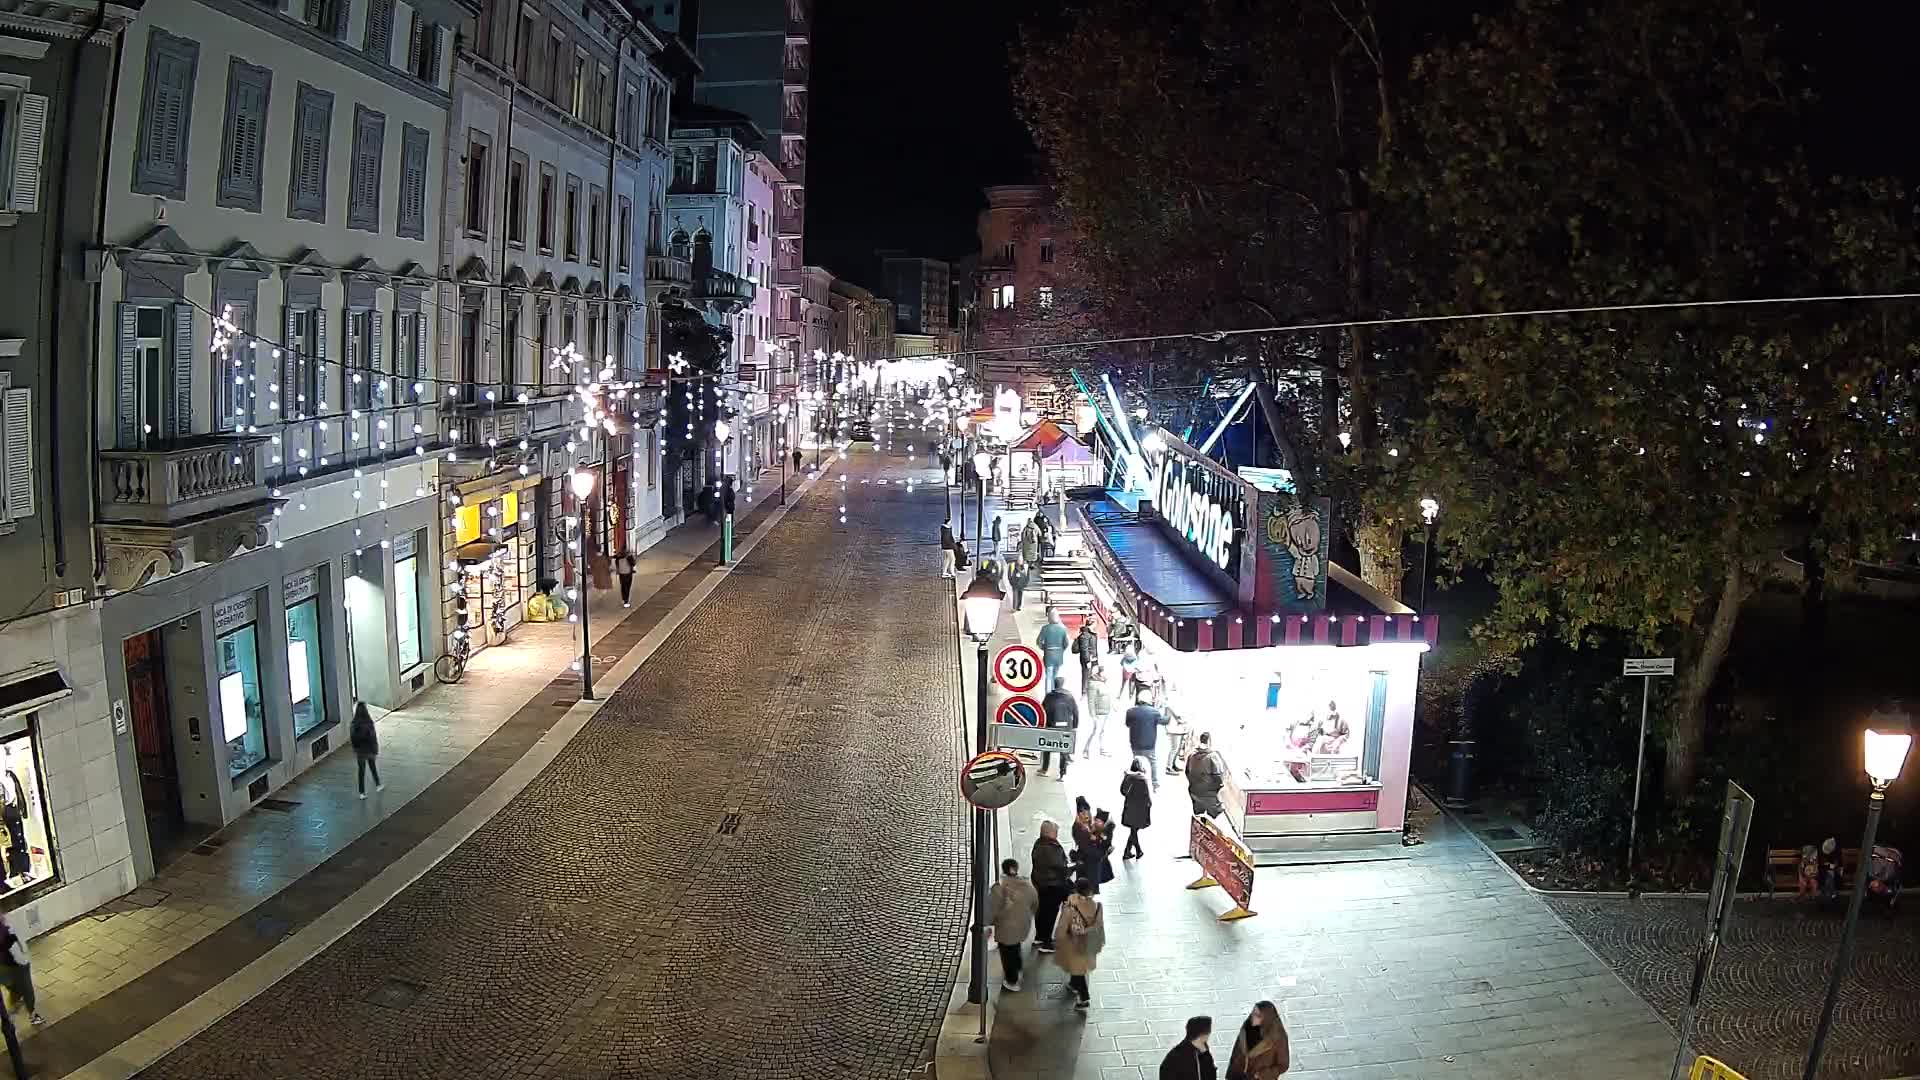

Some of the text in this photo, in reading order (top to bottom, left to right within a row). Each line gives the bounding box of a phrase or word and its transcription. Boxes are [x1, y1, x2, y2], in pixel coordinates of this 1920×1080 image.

[1162, 455, 1233, 570] Golosone
[1006, 658, 1033, 680] 30
[1038, 737, 1069, 748] Dante
